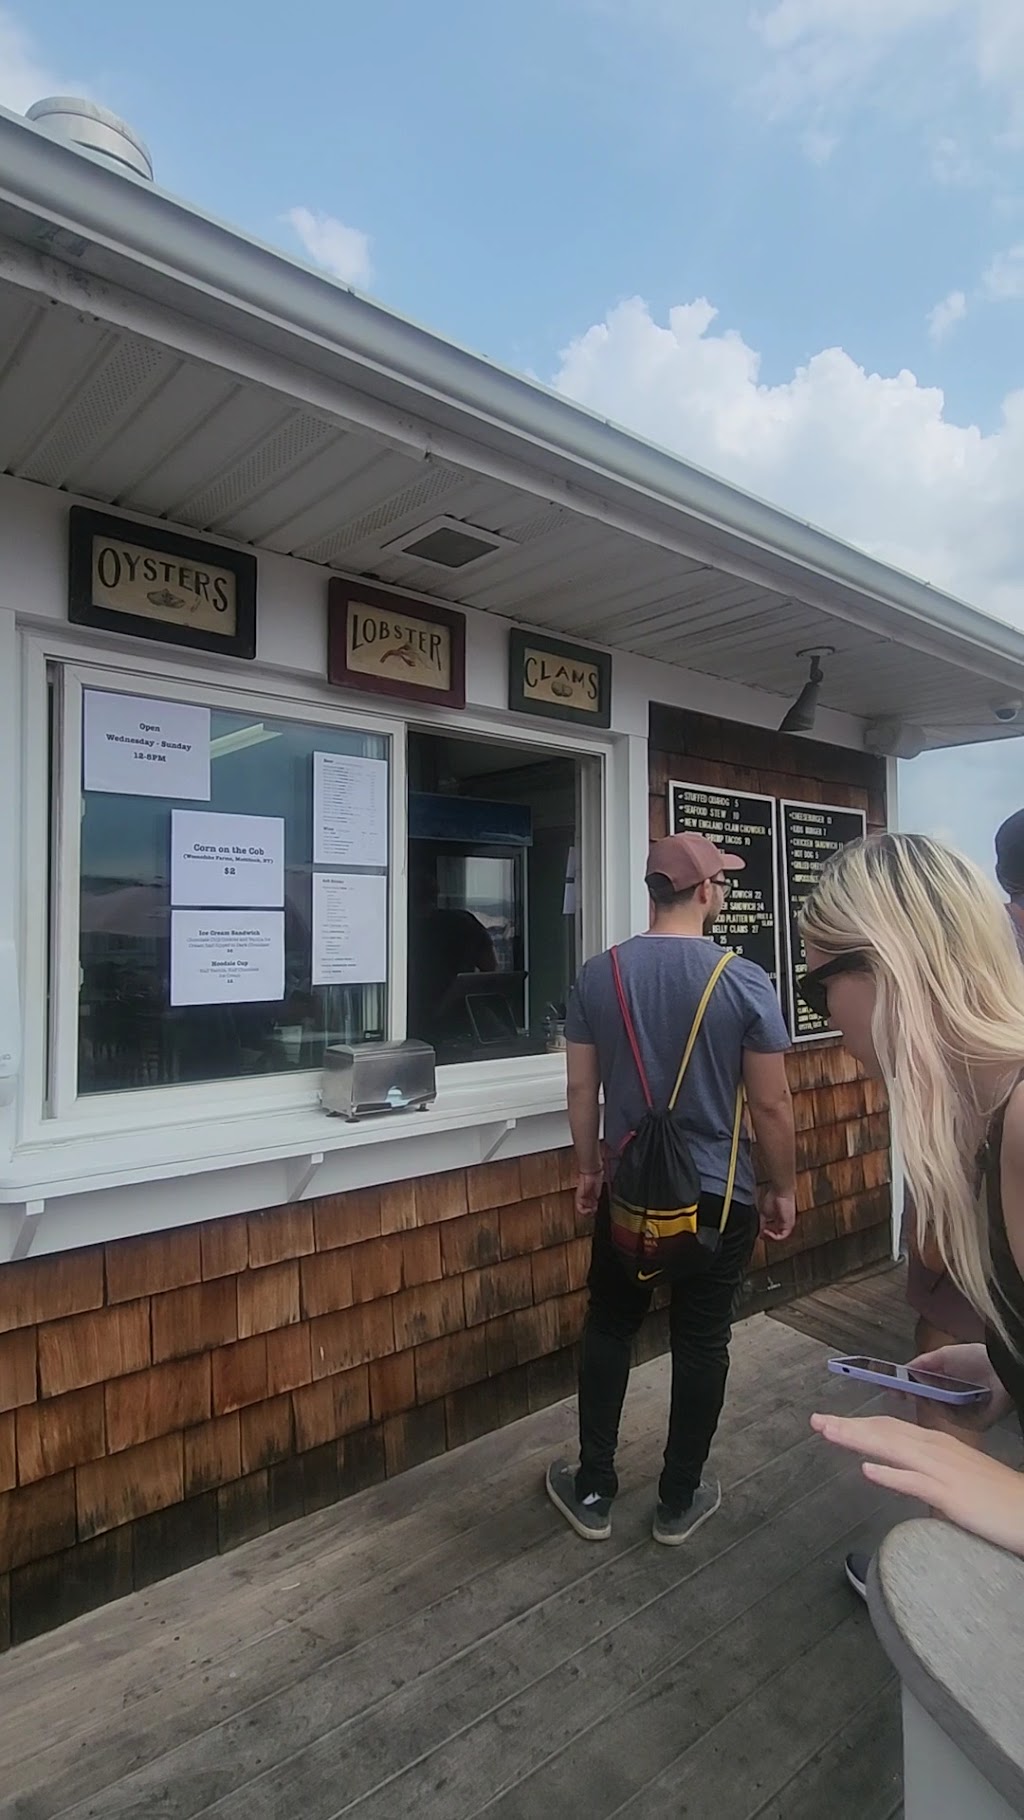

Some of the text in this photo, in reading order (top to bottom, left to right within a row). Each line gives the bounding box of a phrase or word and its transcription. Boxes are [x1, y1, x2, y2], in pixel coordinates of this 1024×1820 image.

[98, 547, 228, 612] OYSTERS
[352, 614, 441, 671] LOBSTER
[525, 657, 597, 700] CLAMS
[139, 722, 160, 732] Open
[106, 733, 155, 748] Wednesday
[161, 741, 192, 752] Sunday
[684, 792, 707, 803] STUFFED
[684, 804, 708, 816] SEAFOOD
[709, 808, 727, 818] STEW
[684, 818, 697, 827] NEW
[698, 819, 723, 830] ENGLAND
[724, 823, 739, 833] CLAM
[740, 824, 766, 835] CHOWDER
[724, 834, 742, 845] TACOS
[793, 838, 813, 848] CHICKEN
[814, 840, 838, 849] SANDWICH
[193, 843, 216, 853] Corn
[232, 846, 247, 854] the
[248, 847, 264, 855] Cob
[804, 850, 814, 858] DOG
[224, 867, 236, 875] $2
[754, 891, 762, 899] 22
[729, 902, 756, 911] SANDWICH
[712, 925, 759, 933] BELLY CLAMS 27
